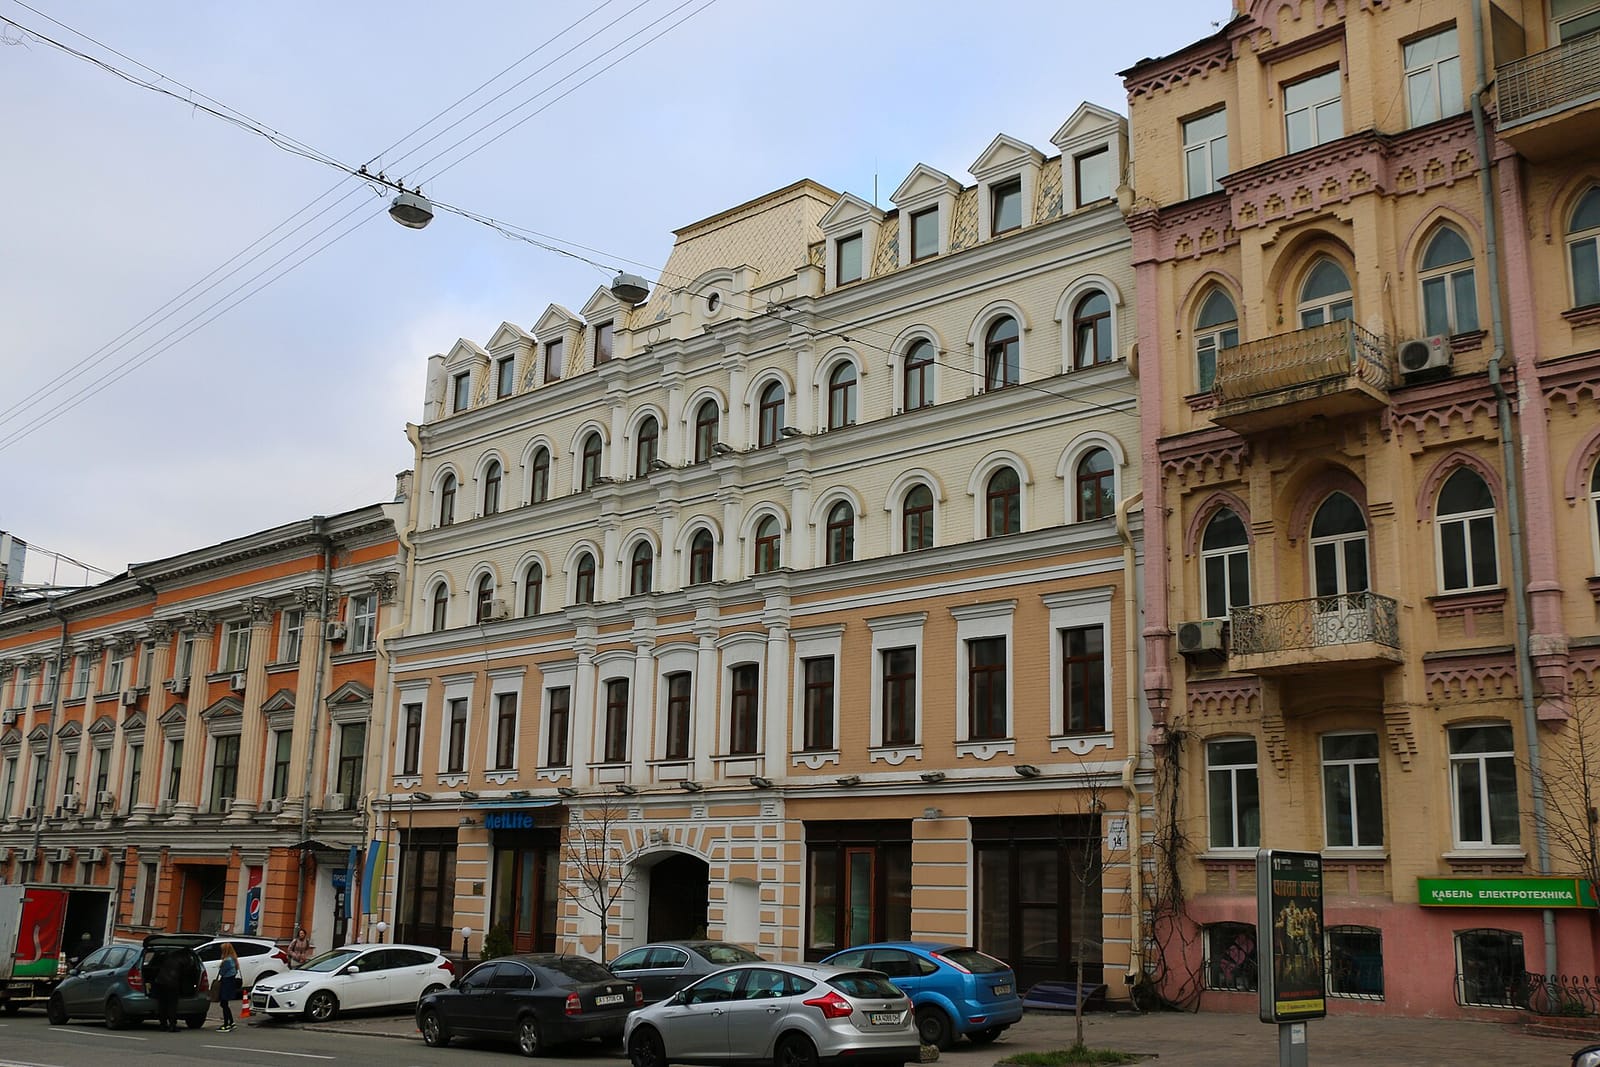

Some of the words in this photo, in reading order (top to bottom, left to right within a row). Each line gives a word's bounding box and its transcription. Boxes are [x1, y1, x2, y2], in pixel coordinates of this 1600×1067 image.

[485, 812, 534, 829] MetLife
[1432, 890, 1473, 898] КАБЕЛЬ
[1478, 890, 1573, 899] ЕЛЕКТРОТЕХНІКА
